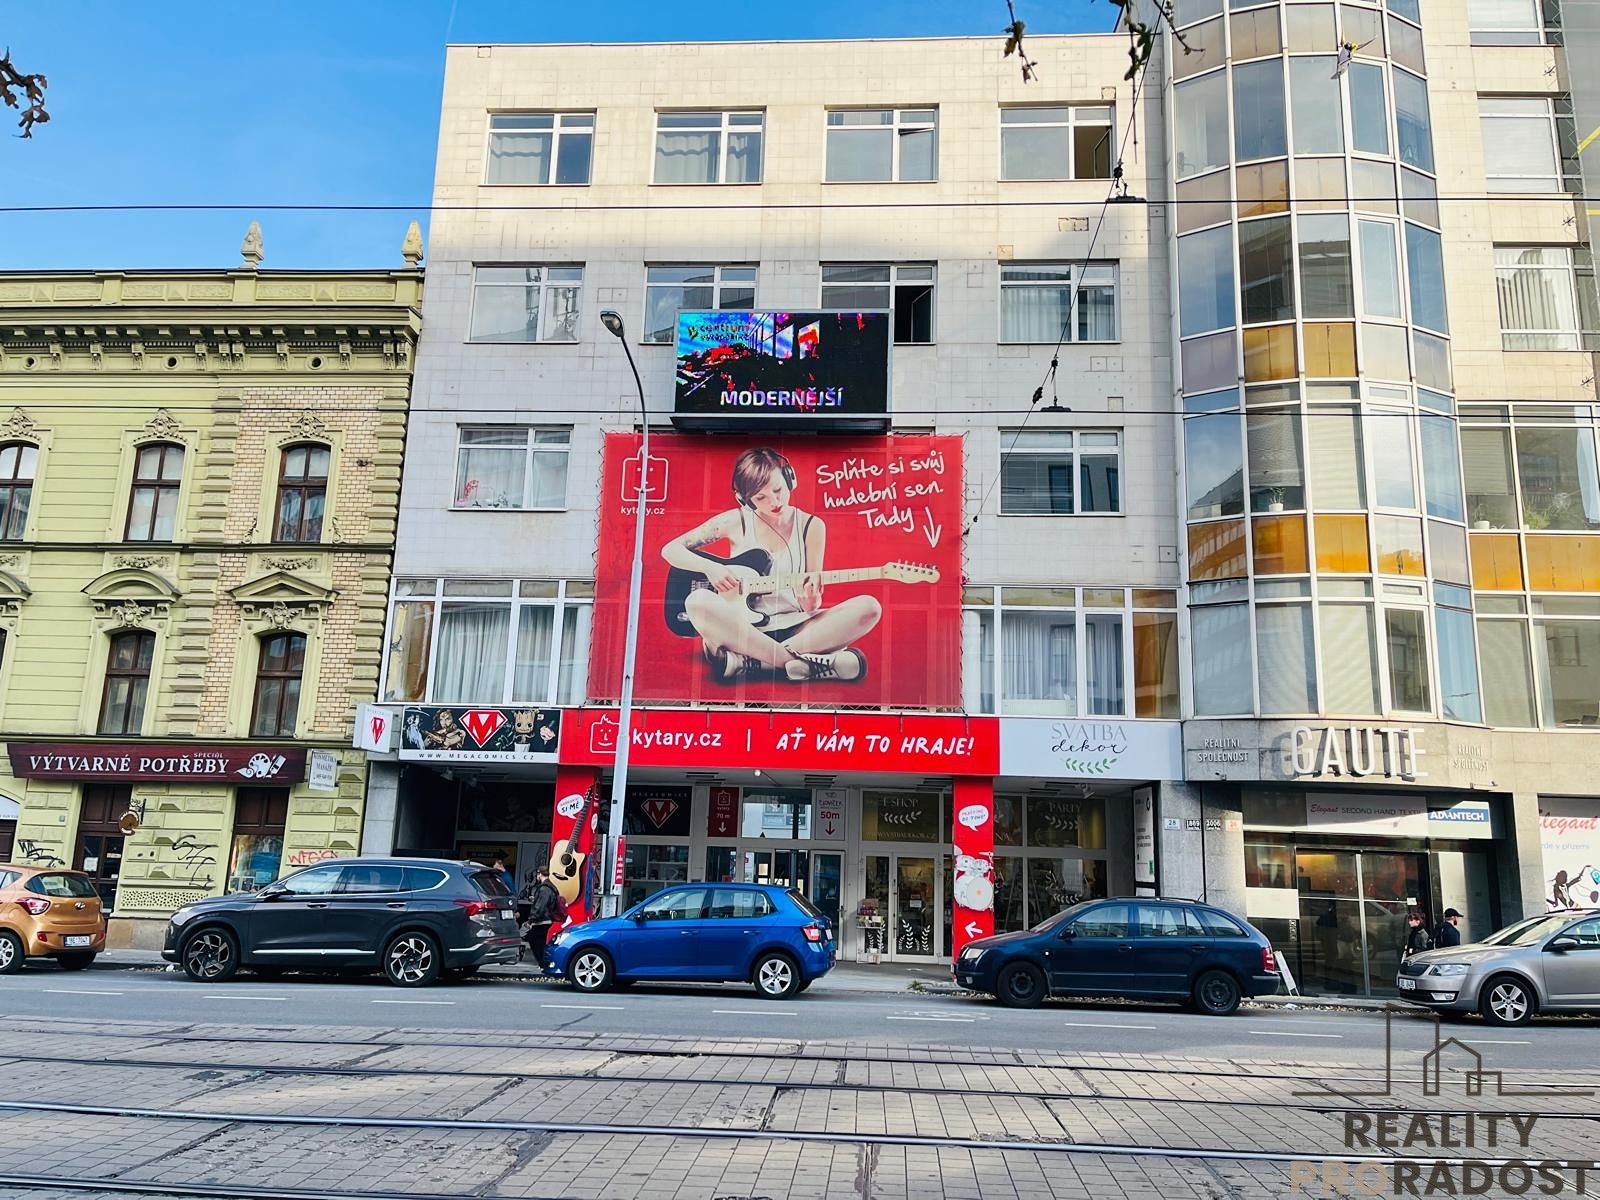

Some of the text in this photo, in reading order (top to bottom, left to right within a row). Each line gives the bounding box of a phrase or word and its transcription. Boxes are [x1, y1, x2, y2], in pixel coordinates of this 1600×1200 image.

[720, 386, 845, 406] MODERNĚJŠÍ
[816, 449, 945, 489] Splňte si svůj
[823, 480, 944, 509] hudební sen.
[858, 505, 915, 533] Tady
[632, 727, 722, 749] kytary.cz
[776, 727, 975, 756] AŤ VÁM TO HRAJE!
[1051, 722, 1127, 741] SVATBA
[1051, 739, 1128, 754] dekor
[1291, 726, 1429, 778] GAUTE
[29, 752, 230, 774] VÝTVARNÉ POTŘEBY
[820, 811, 840, 819] 50m
[1310, 803, 1339, 815] Elegant
[1341, 806, 1373, 815] SECOND
[1373, 808, 1396, 816] HAND
[1429, 810, 1485, 821] ADVANTECH
